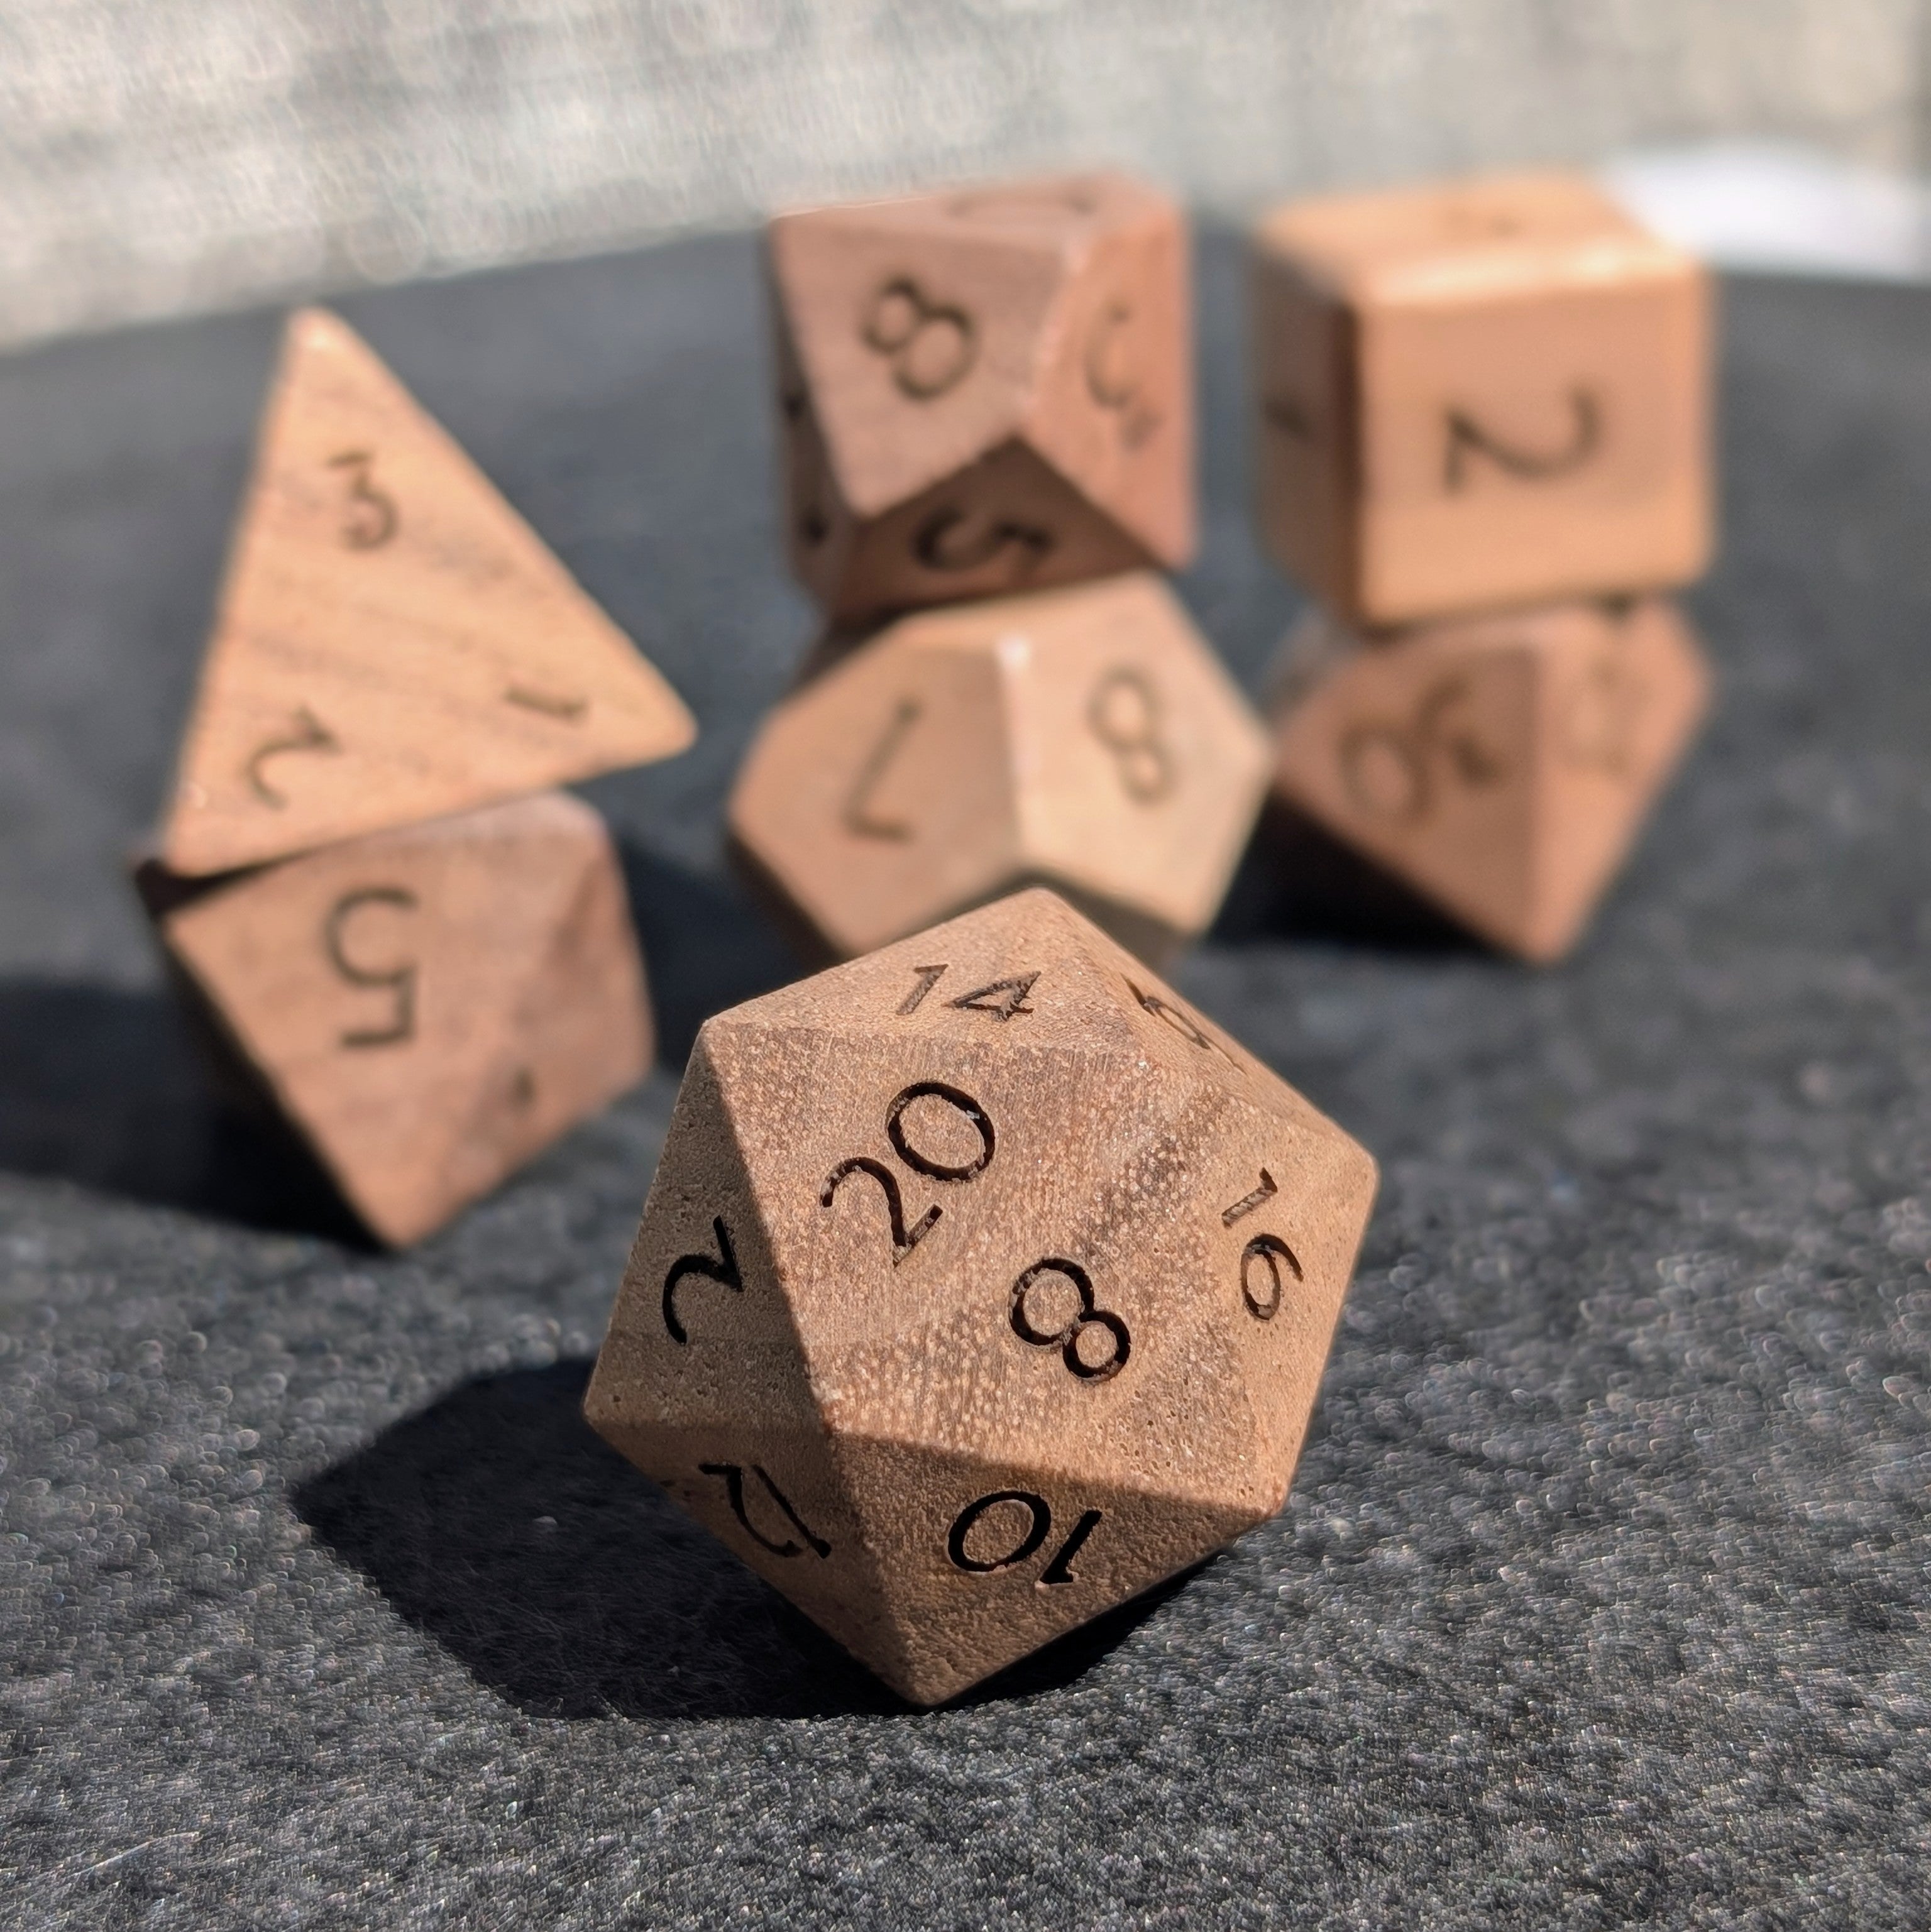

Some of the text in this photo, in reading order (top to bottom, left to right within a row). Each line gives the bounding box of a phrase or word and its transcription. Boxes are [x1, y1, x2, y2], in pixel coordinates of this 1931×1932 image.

[860, 274, 978, 402] 8
[1441, 381, 1603, 497] 2
[243, 700, 342, 812] 2
[503, 684, 591, 725] 1
[844, 693, 923, 843] 7
[1090, 665, 1174, 807] 8
[322, 886, 419, 1050] 5
[895, 963, 1042, 1022] 14
[819, 1080, 995, 1268] 20
[661, 1214, 744, 1346] 2
[1221, 1166, 1304, 1320] 16
[1008, 1257, 1131, 1383] 8
[947, 1490, 1103, 1586] 10
